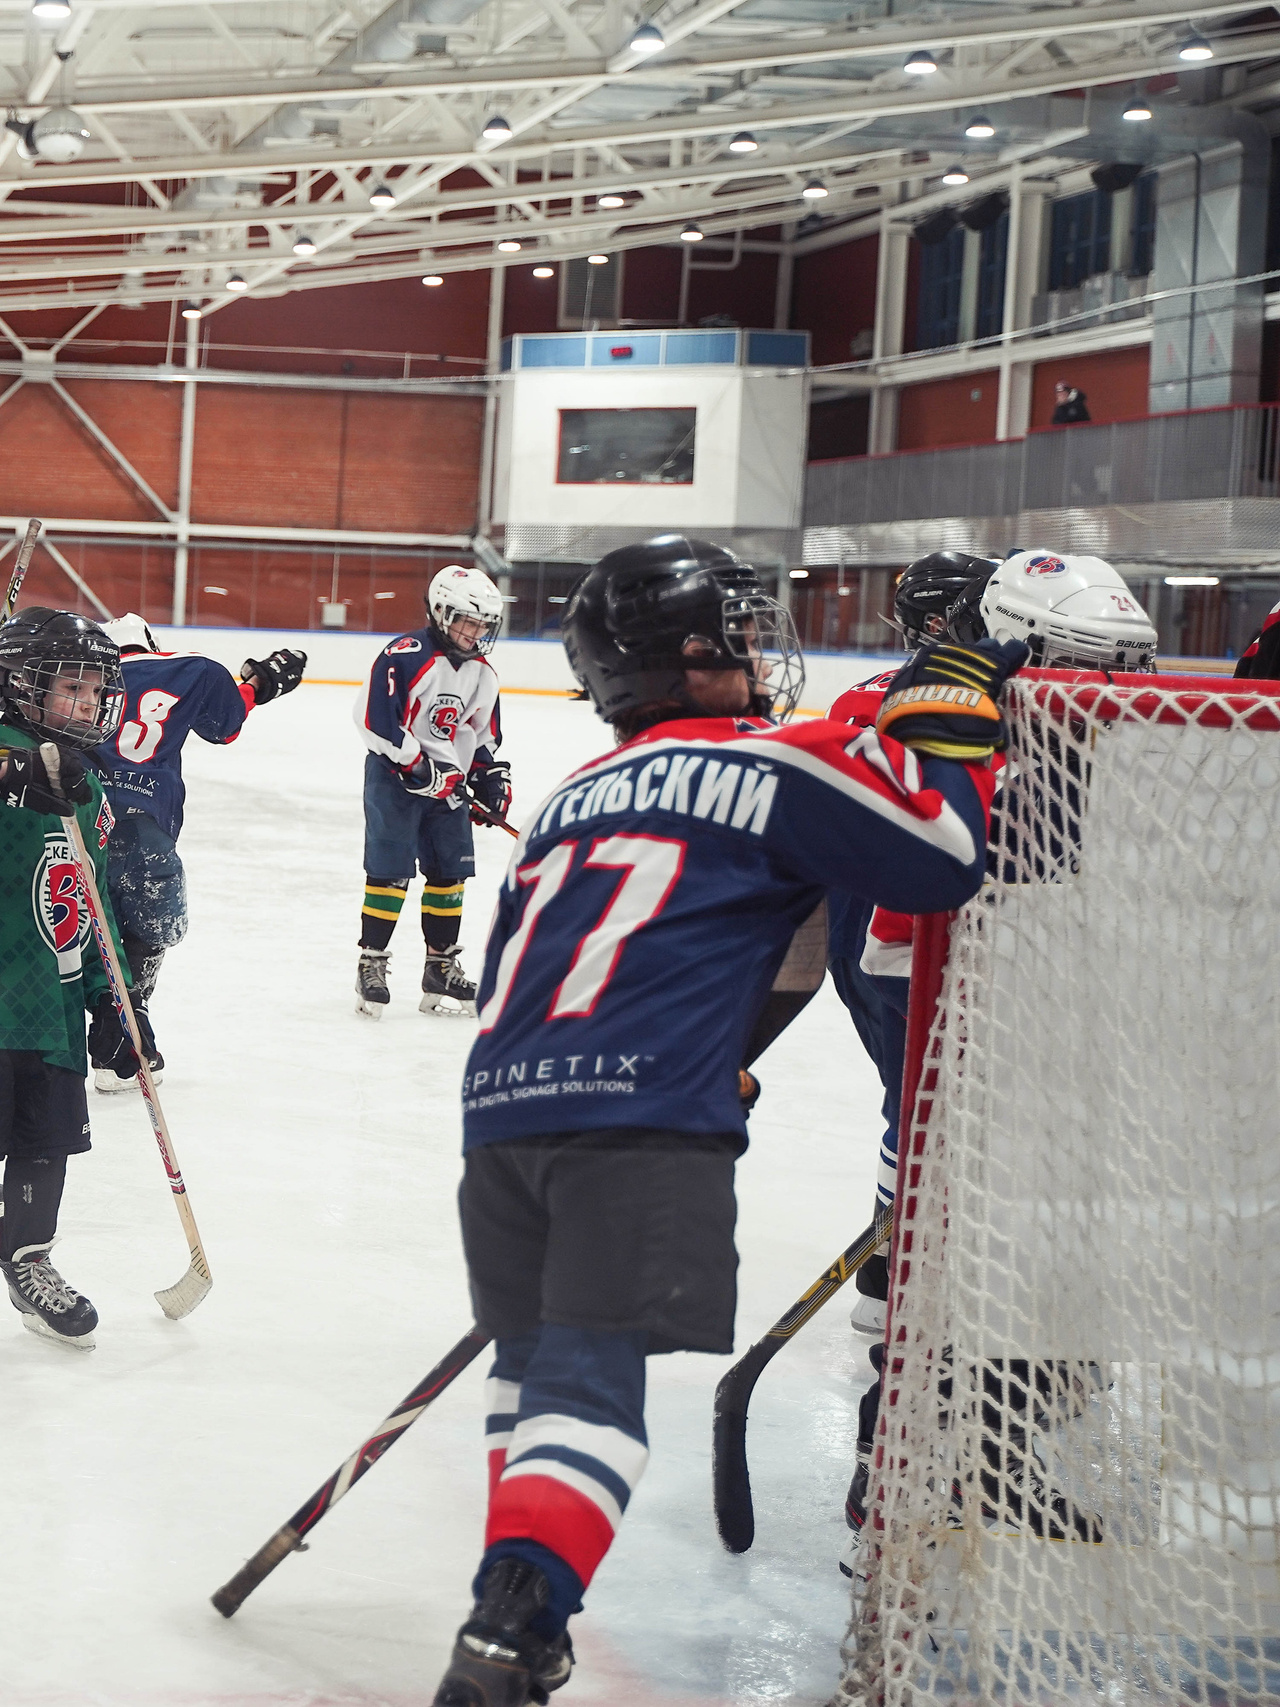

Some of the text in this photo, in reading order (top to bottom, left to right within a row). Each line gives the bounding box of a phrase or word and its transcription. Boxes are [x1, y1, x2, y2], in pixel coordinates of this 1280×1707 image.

[995, 605, 1025, 623] BAUER
[90, 644, 119, 657] BAUER
[1116, 639, 1152, 650] BAUER
[478, 831, 689, 1037] 17
[477, 1091, 511, 1109] DIGITAL
[512, 1082, 559, 1100] SIGNAGE
[560, 1080, 635, 1094] SOLUTIONS
